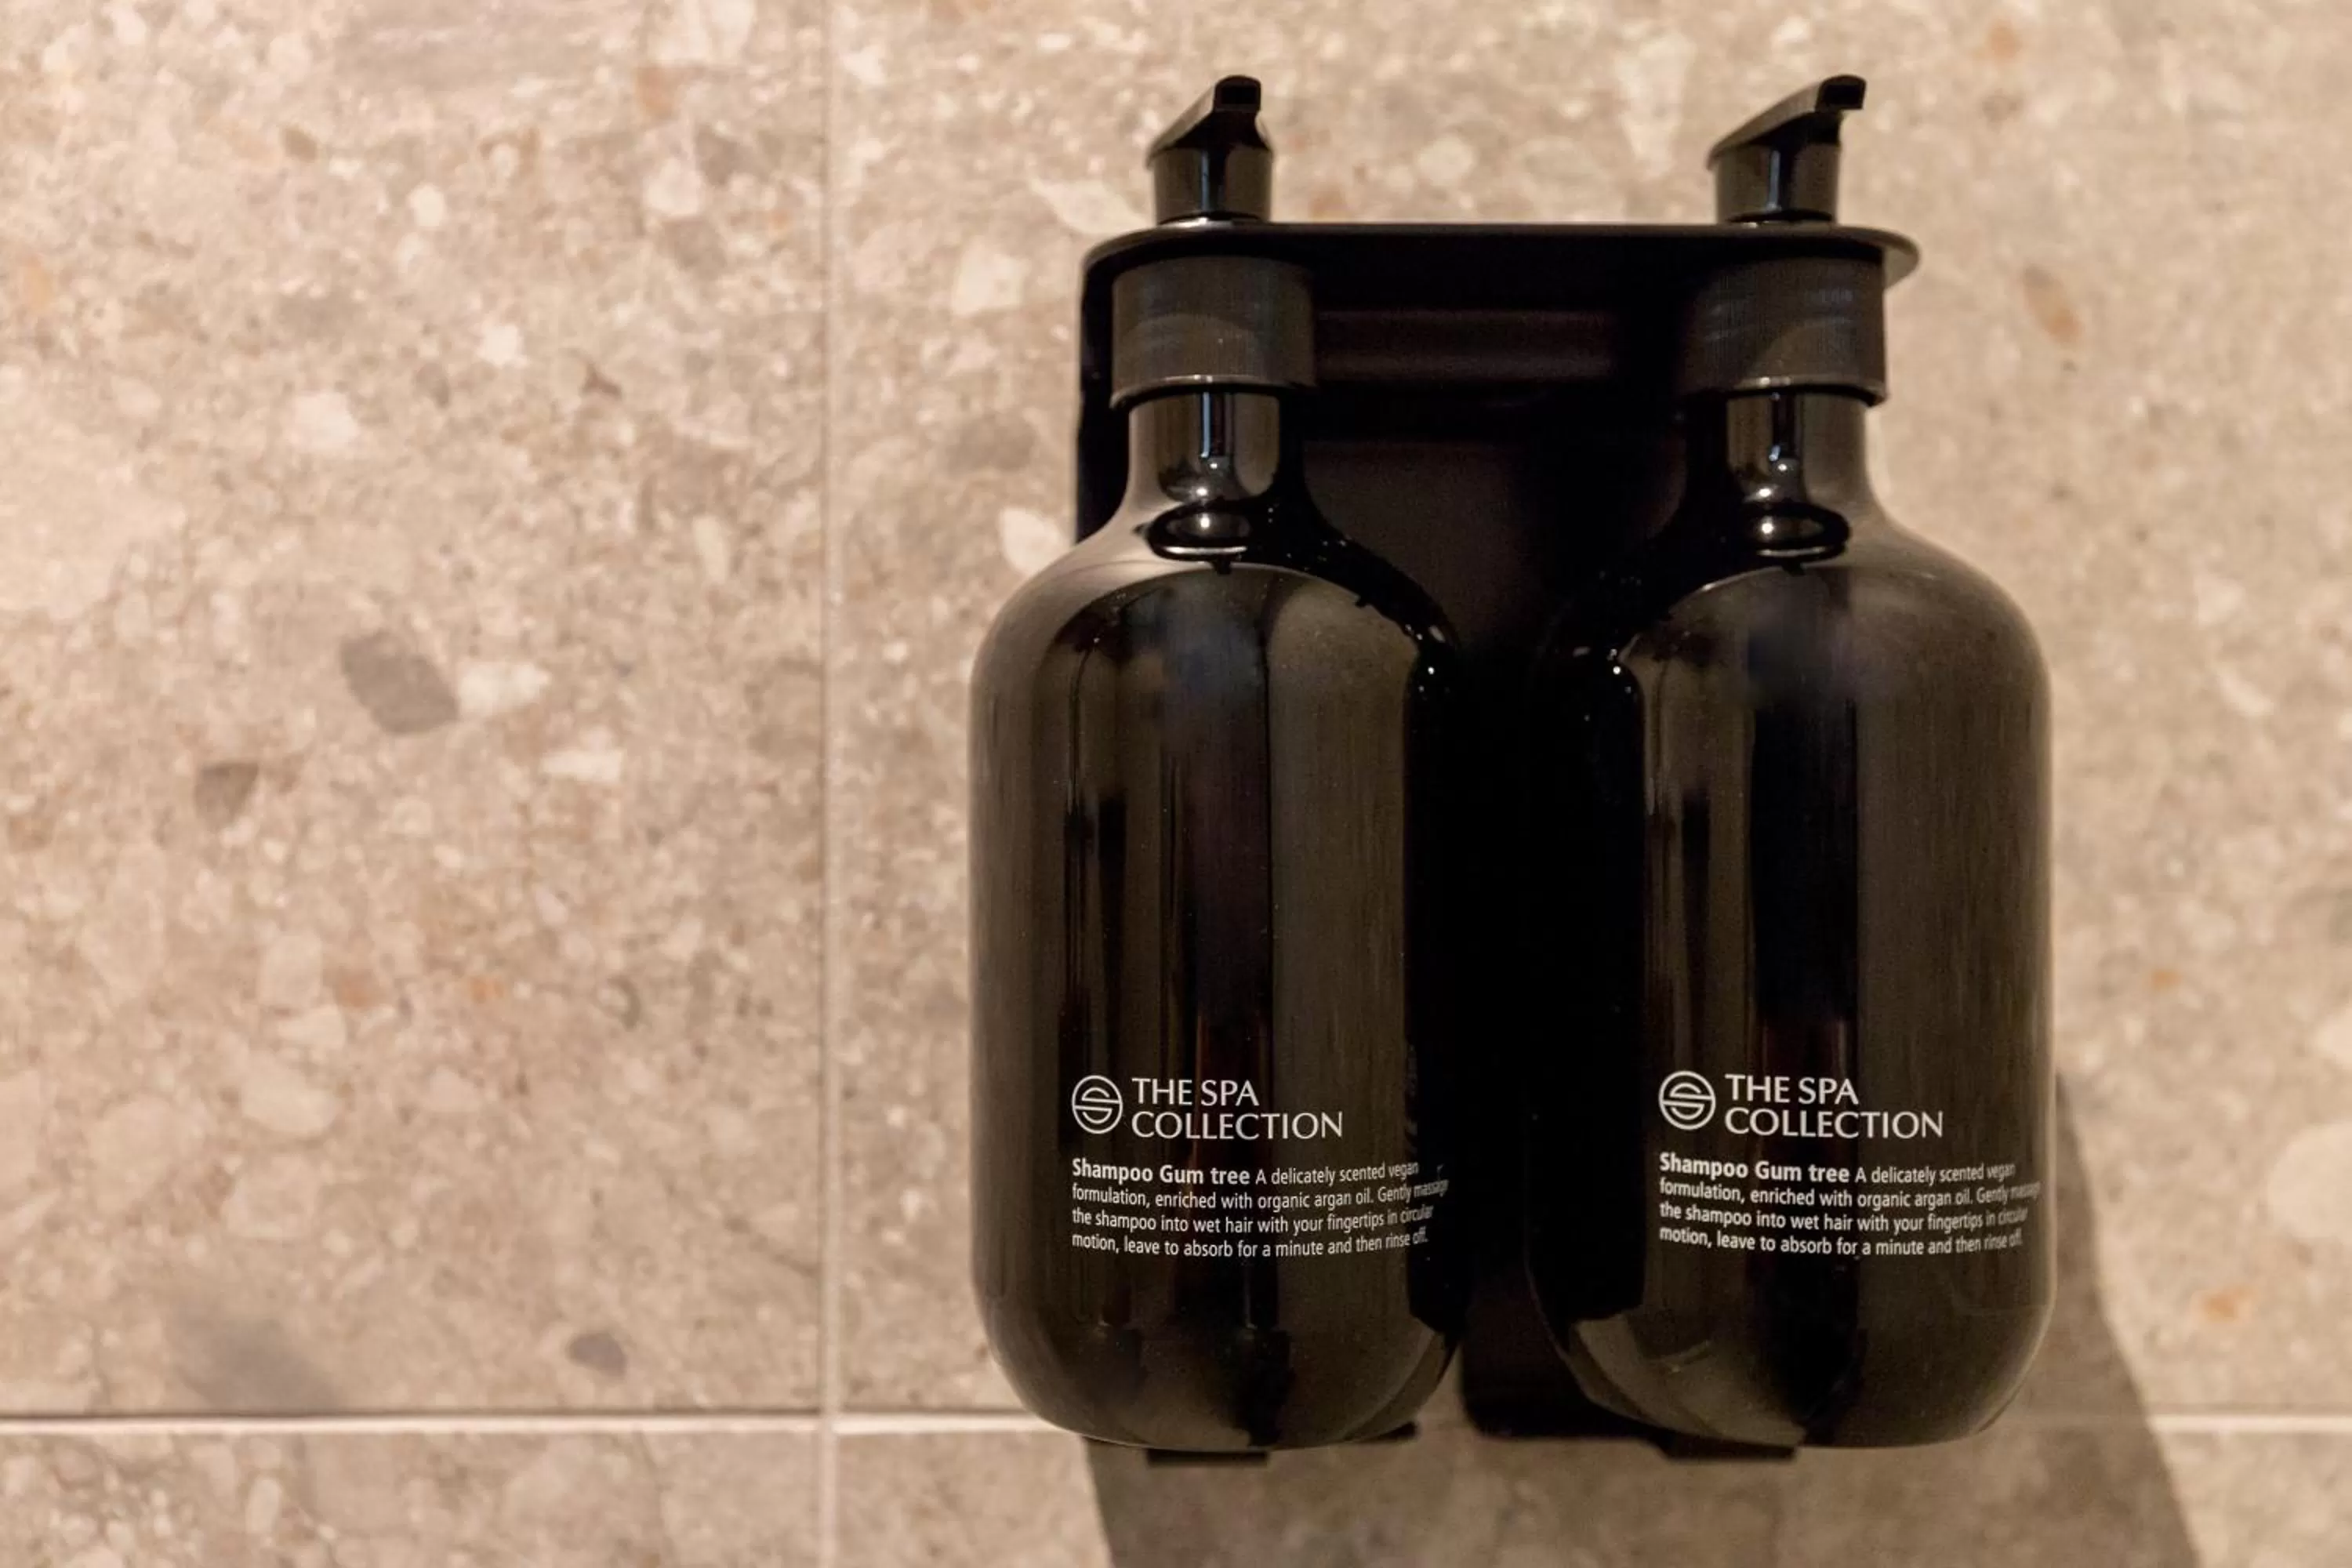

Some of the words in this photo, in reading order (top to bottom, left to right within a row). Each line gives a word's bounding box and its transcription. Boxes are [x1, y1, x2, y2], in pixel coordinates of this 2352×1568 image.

[1131, 1077, 1192, 1106] THE
[1200, 1079, 1260, 1107] SPA
[1725, 1073, 1790, 1104] THE
[1798, 1076, 1859, 1105] SPA
[1131, 1110, 1344, 1141] COLLECTION
[1725, 1106, 1944, 1139] COLLECTION
[1072, 1157, 1153, 1185] Shampoo
[1160, 1164, 1204, 1185] Gum
[1210, 1167, 1250, 1185] tree
[1255, 1168, 1267, 1185] A
[1271, 1166, 1335, 1187] delicately
[1339, 1160, 1386, 1182] scented
[1388, 1162, 1420, 1181] vegan
[1659, 1151, 1749, 1181] Shampoo
[1754, 1160, 1802, 1181] Gum
[1807, 1163, 1850, 1183] tree
[1854, 1167, 1867, 1183] A
[1871, 1165, 1936, 1187] delicately
[1939, 1161, 1984, 1182] scented
[1986, 1163, 2016, 1182] vegan
[1072, 1182, 1151, 1209] formulation,
[1155, 1191, 1217, 1209] enriched
[1221, 1192, 1253, 1209] with
[1258, 1191, 1311, 1213] organic
[1313, 1192, 1352, 1211] argan
[1356, 1187, 1374, 1205] oil.
[1377, 1183, 1412, 1203] Gently
[1659, 1176, 1745, 1205] formulation,
[1749, 1186, 1815, 1206] enriched
[1819, 1189, 1853, 1207] with
[1857, 1190, 1911, 1212] organic
[1914, 1192, 1951, 1211] argan
[1955, 1188, 1973, 1205] oil.
[1976, 1184, 2009, 1206] Gently
[1072, 1207, 1092, 1225] the
[1095, 1208, 1156, 1233] shampoo
[1160, 1214, 1189, 1232] into
[1192, 1218, 1221, 1233] wet
[1225, 1216, 1254, 1233] hair
[1257, 1216, 1288, 1233] with
[1293, 1218, 1323, 1236] your
[1327, 1210, 1385, 1234] fingertips
[1387, 1208, 1398, 1225] in
[1659, 1201, 1682, 1219] the
[1685, 1203, 1752, 1229] shampoo
[1755, 1210, 1787, 1229] into
[1790, 1214, 1819, 1230] wet
[1824, 1213, 1853, 1231] hair
[1857, 1214, 1889, 1232] with
[1893, 1217, 1925, 1236] your
[1927, 1212, 1984, 1235] fingertips
[1985, 1209, 1996, 1227] in
[1072, 1232, 1120, 1254] motion,
[1123, 1234, 1160, 1254] leave
[1164, 1240, 1179, 1255] to
[1183, 1238, 1233, 1258] absorb
[1237, 1239, 1258, 1257] for
[1261, 1244, 1272, 1258] a
[1276, 1240, 1324, 1258] minute
[1327, 1236, 1352, 1254] and
[1356, 1235, 1382, 1252] then
[1385, 1232, 1411, 1249] rinse
[1659, 1225, 1712, 1249] motion,
[1716, 1229, 1755, 1250] leave
[1759, 1236, 1776, 1252] to
[1780, 1236, 1832, 1255] absorb
[1836, 1236, 1858, 1255] for
[1861, 1241, 1871, 1255] a
[1875, 1238, 1925, 1255] minute
[1927, 1236, 1952, 1254] and
[1955, 1235, 1982, 1253] then
[1984, 1232, 2008, 1250] rinse
